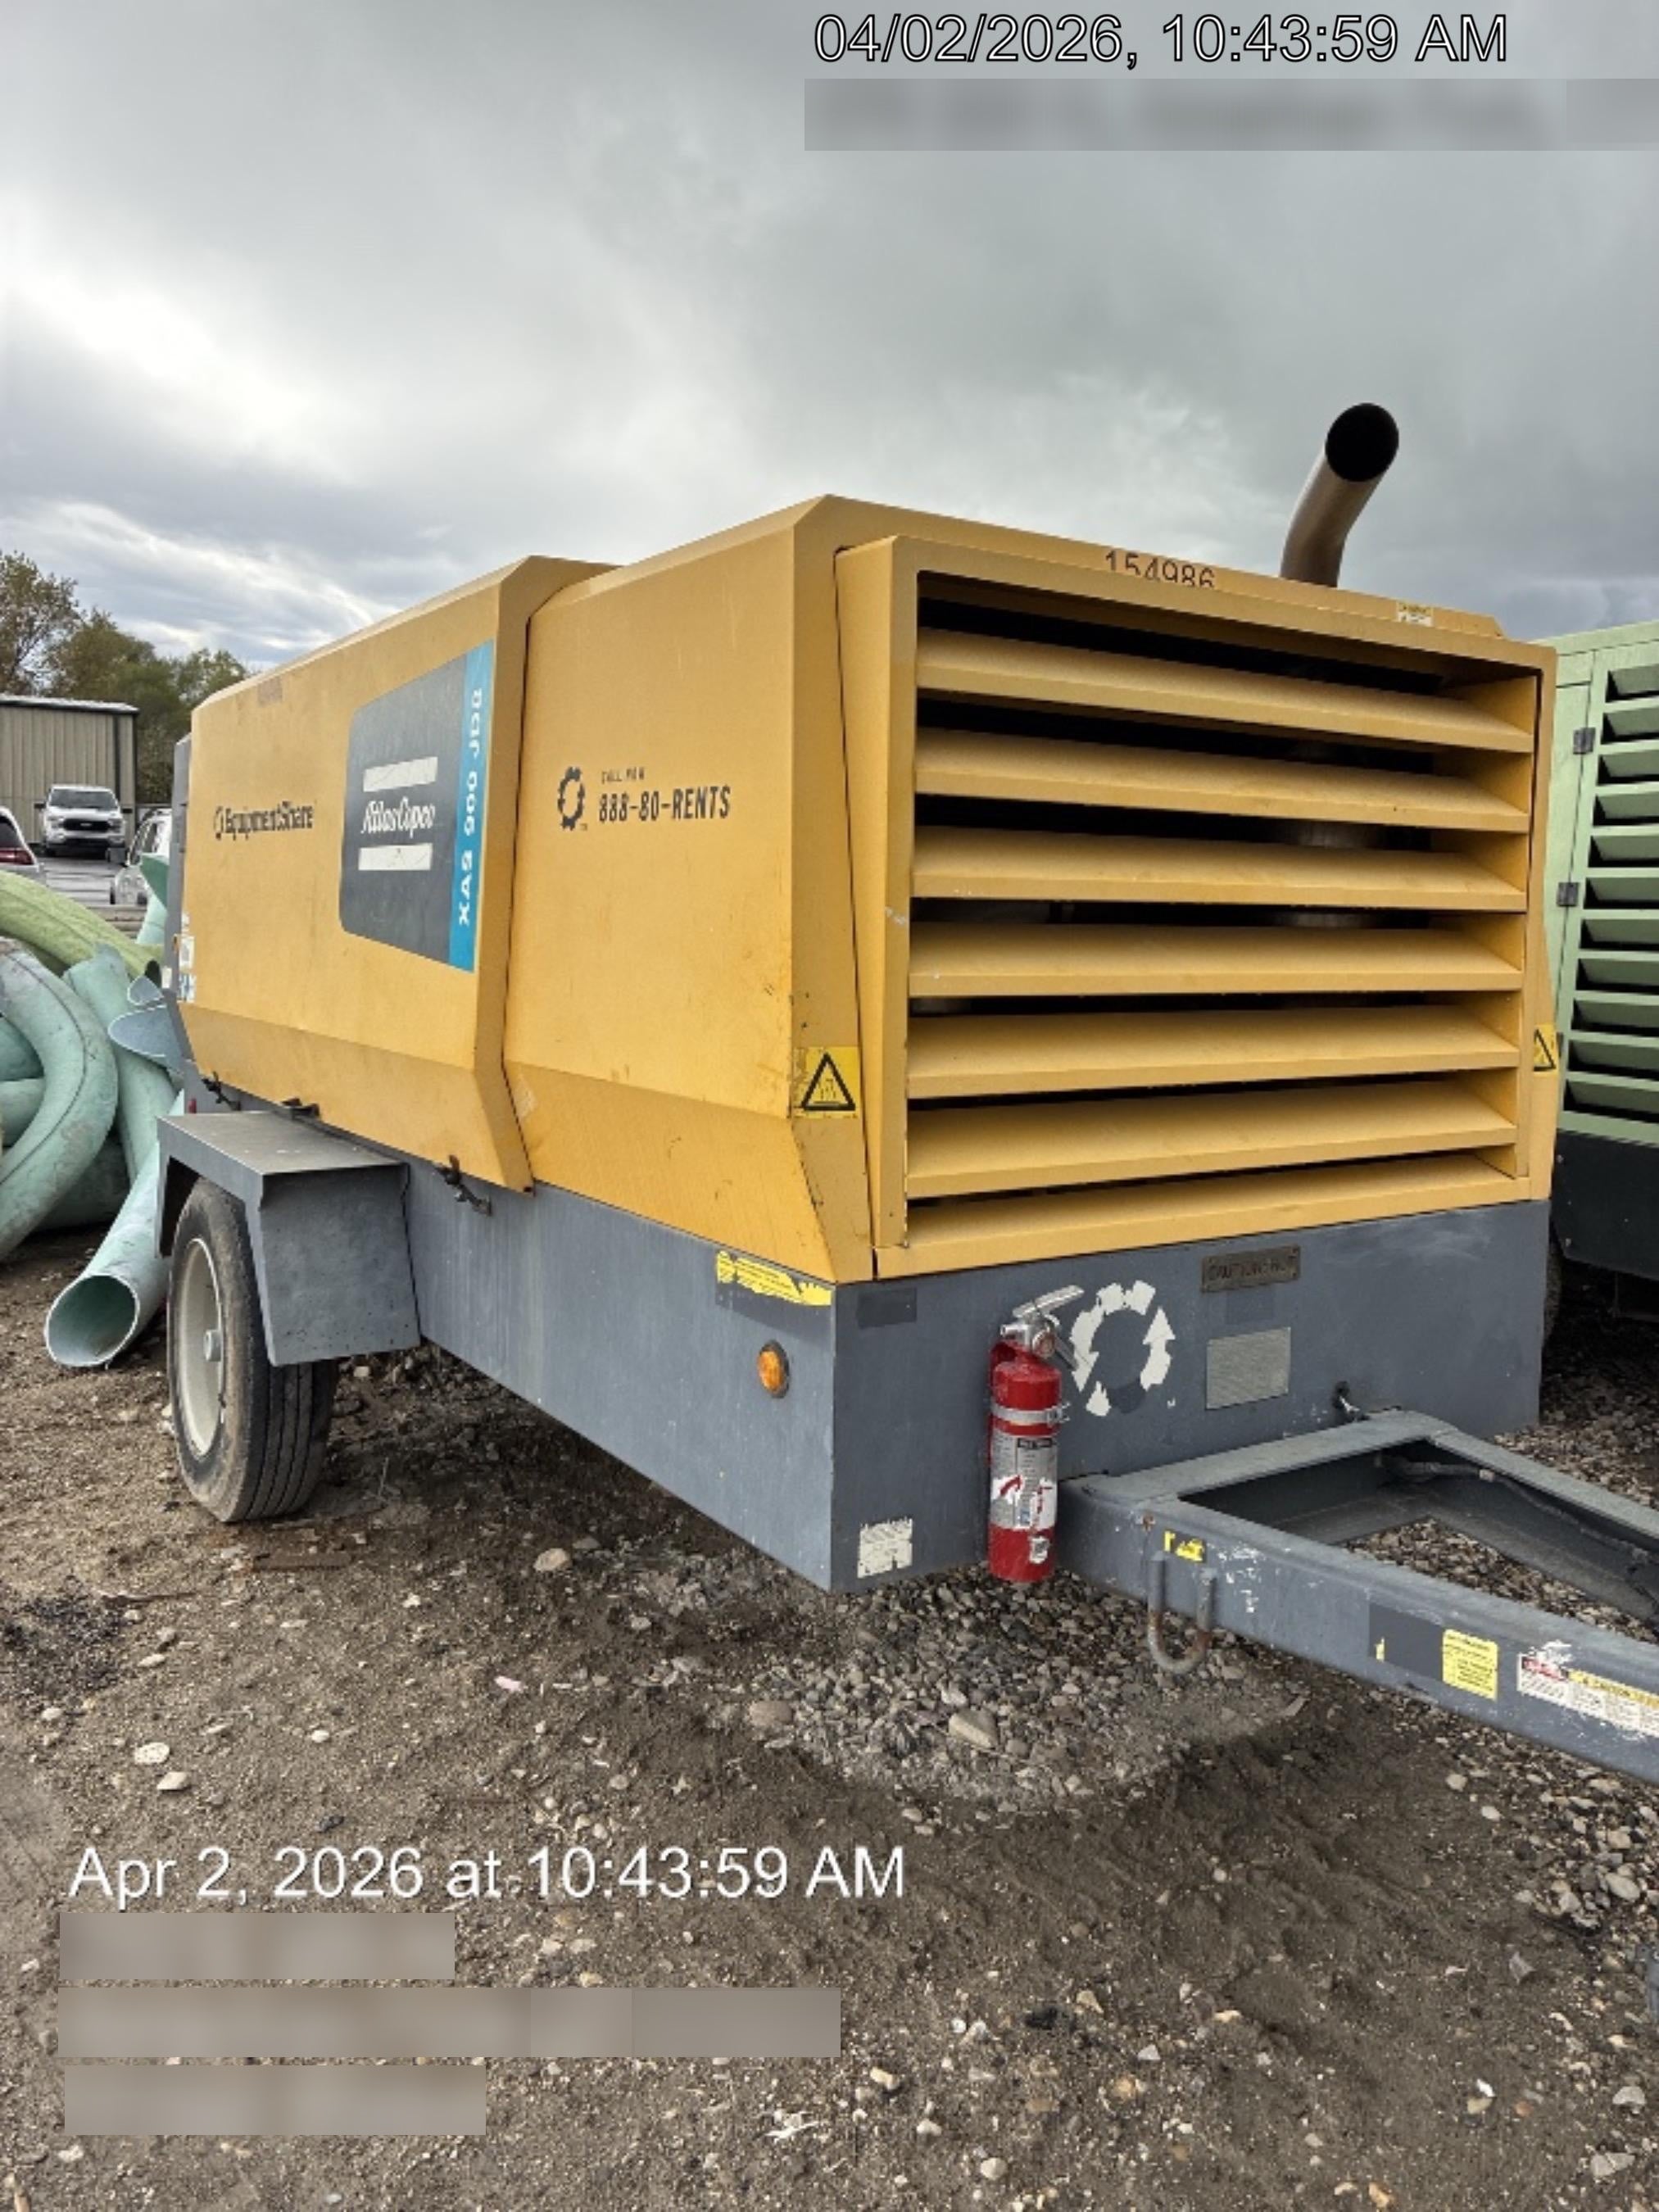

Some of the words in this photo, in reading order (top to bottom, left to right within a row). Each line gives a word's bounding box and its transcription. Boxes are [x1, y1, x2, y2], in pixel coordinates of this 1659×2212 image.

[1105, 549, 1216, 589] 154986
[360, 799, 396, 835] Atlas
[397, 795, 437, 840] Copco
[464, 770, 478, 837] 900
[598, 783, 732, 823] 888-80-RENTS
[459, 850, 474, 926] XAS
